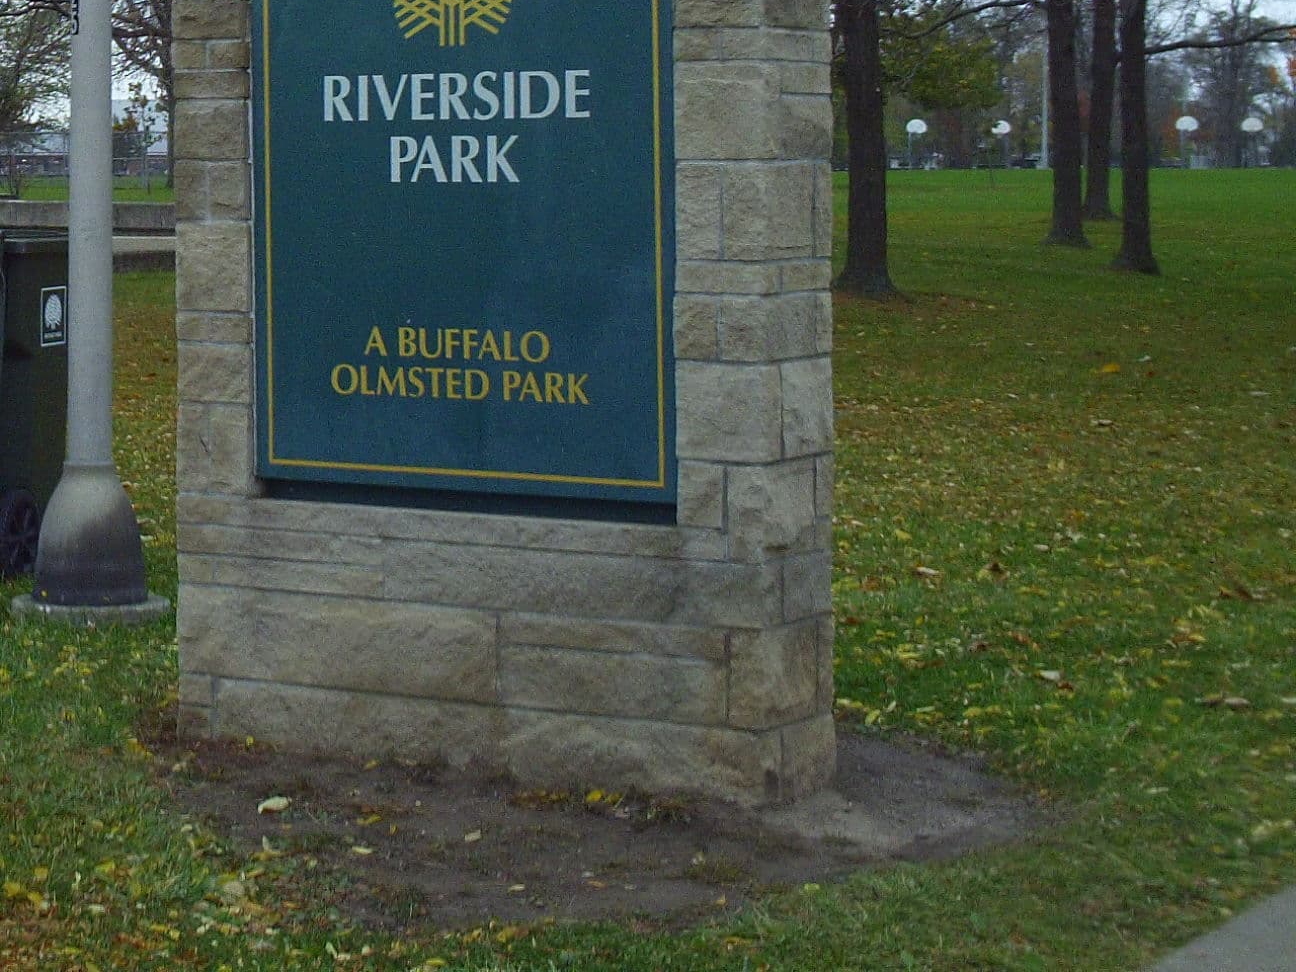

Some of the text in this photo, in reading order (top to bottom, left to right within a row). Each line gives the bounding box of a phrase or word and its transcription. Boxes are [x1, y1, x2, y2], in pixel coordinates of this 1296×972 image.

[323, 70, 591, 122] RIVERSIDE
[390, 134, 520, 183] PARK
[364, 326, 551, 363] A BUFFALO
[330, 363, 590, 405] OLMSTED PARK
